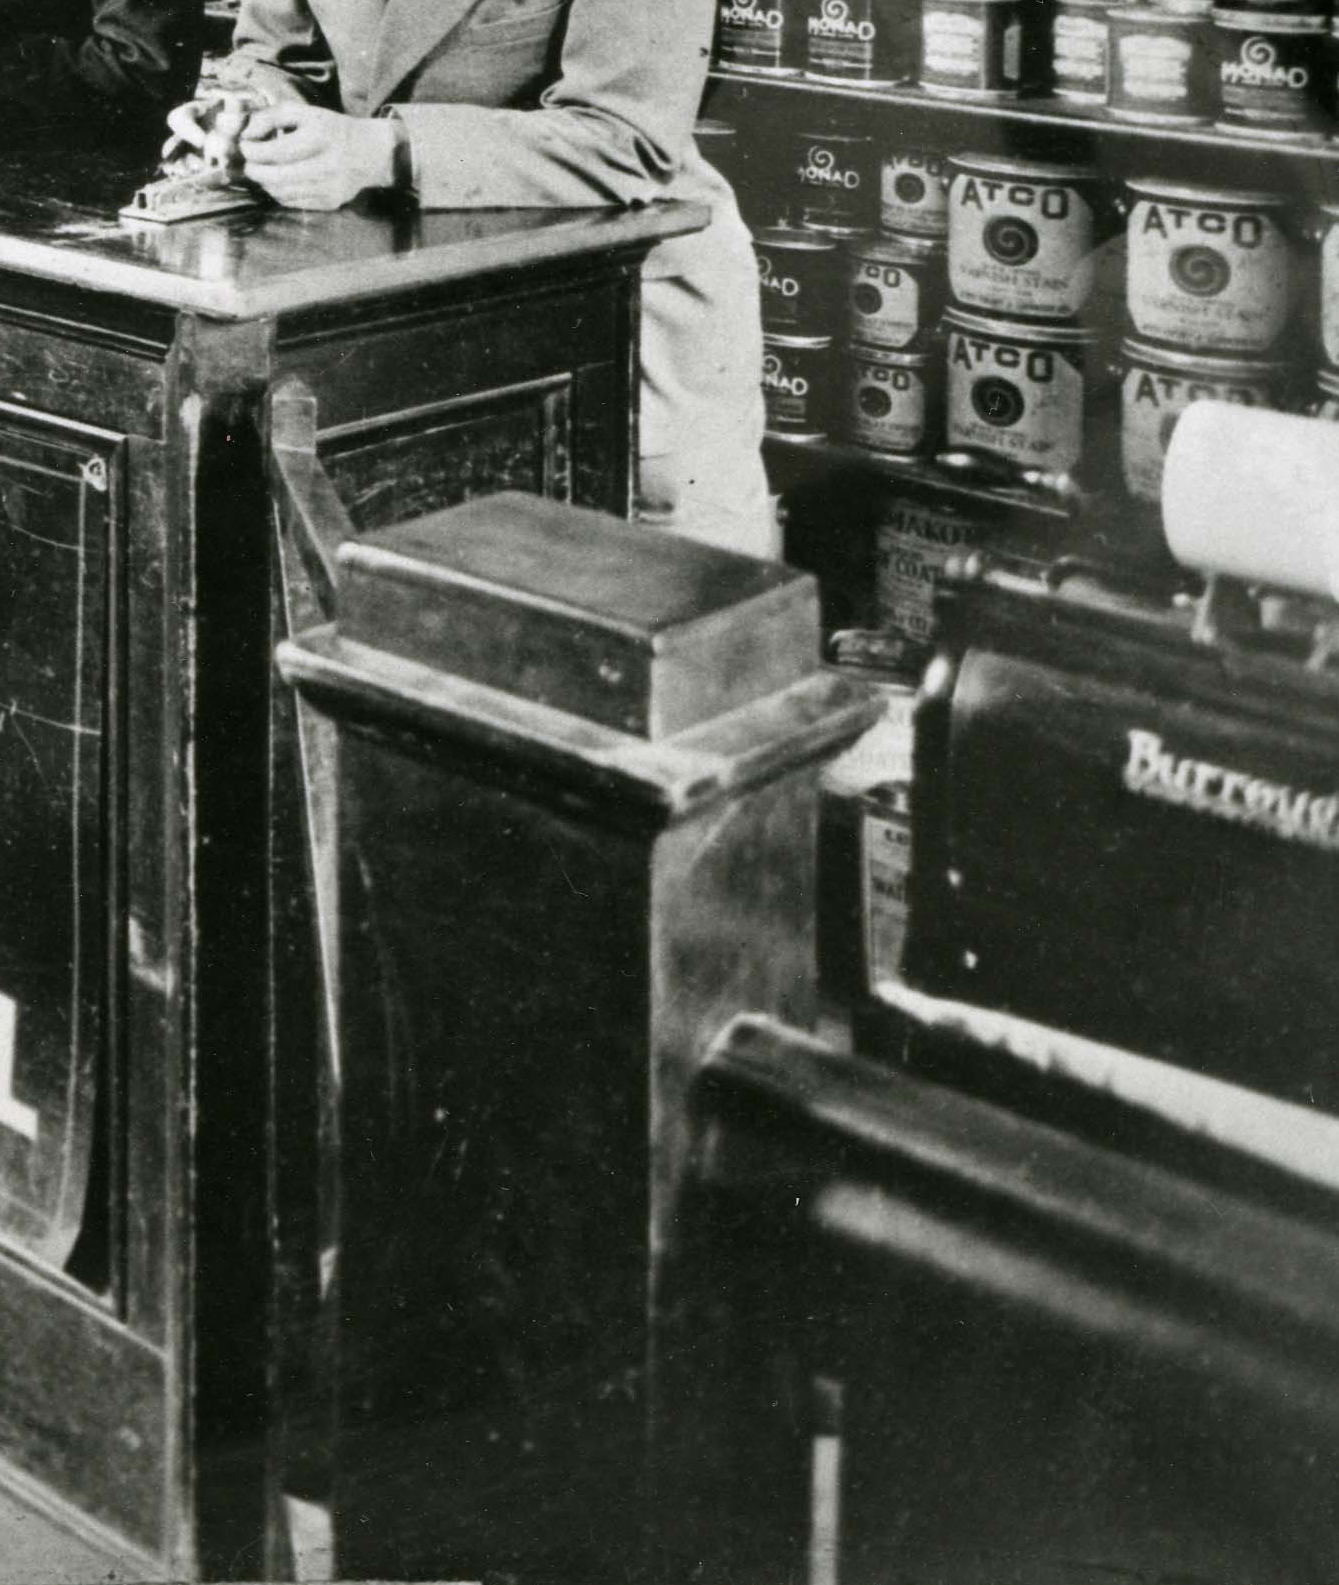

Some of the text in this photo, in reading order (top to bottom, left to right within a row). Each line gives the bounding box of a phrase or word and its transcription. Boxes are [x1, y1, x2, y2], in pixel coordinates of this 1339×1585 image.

[808, 17, 876, 41] MONAD
[1221, 60, 1309, 88] MONAD
[960, 176, 1070, 220] ATCO
[1143, 204, 1264, 250] ATCO
[952, 334, 1054, 385] ATCO
